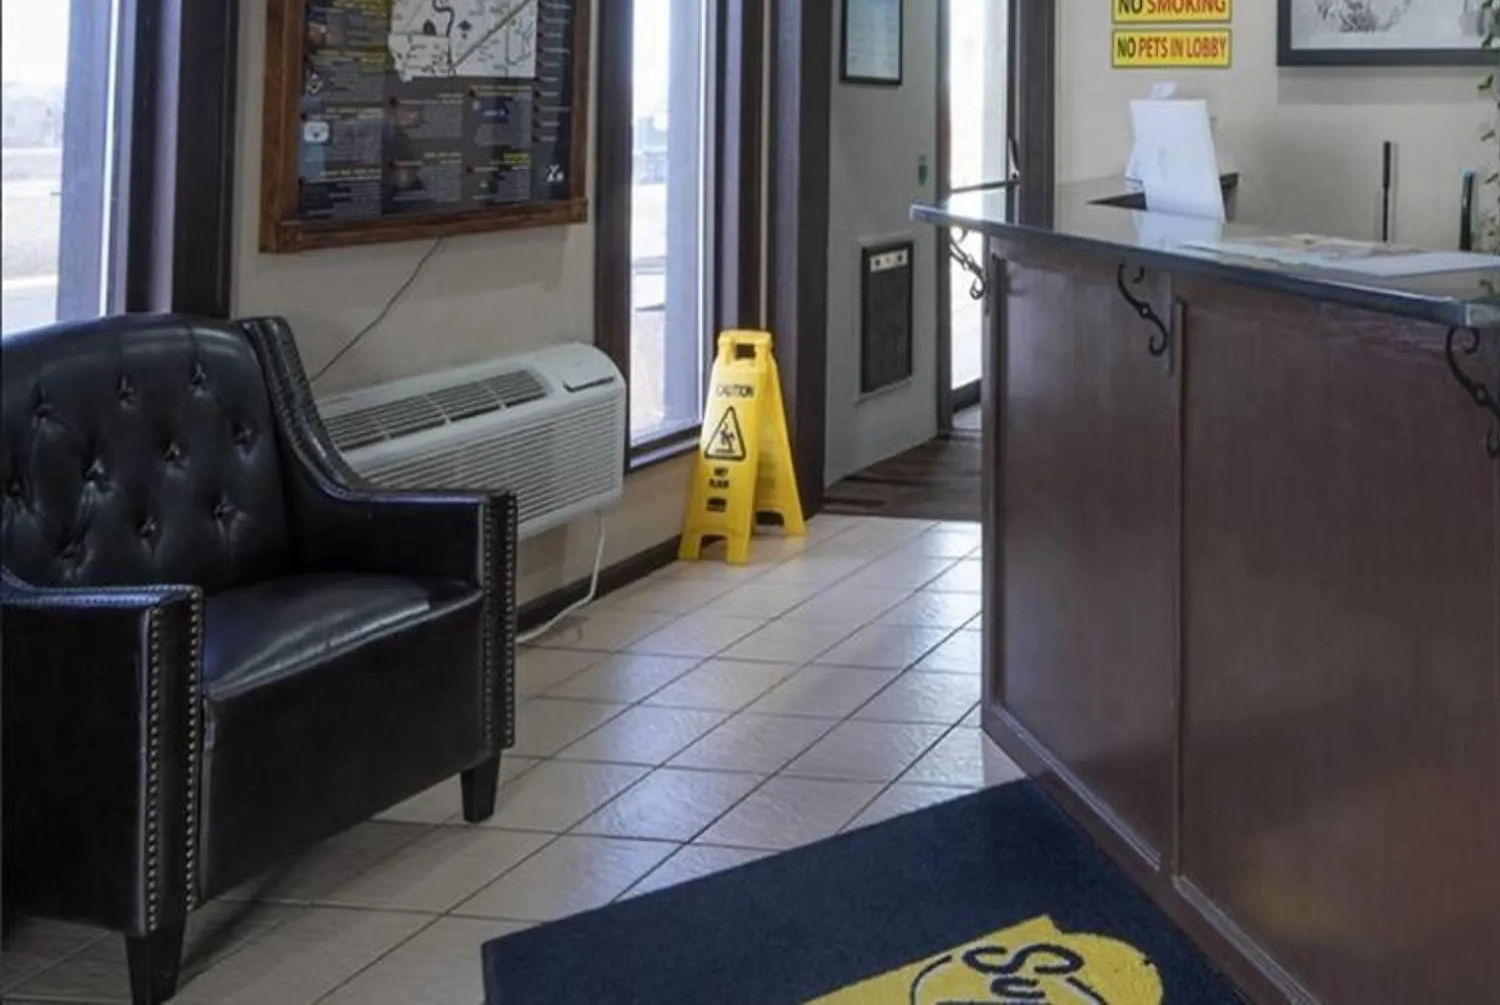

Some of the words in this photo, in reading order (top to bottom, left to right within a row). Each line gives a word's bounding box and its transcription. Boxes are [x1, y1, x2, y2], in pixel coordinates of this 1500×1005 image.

[1117, 37, 1136, 59] NO
[1138, 37, 1168, 58] PETS
[1170, 37, 1184, 57] IN
[1186, 36, 1227, 58] LOBBY
[715, 384, 754, 398] CAUTION
